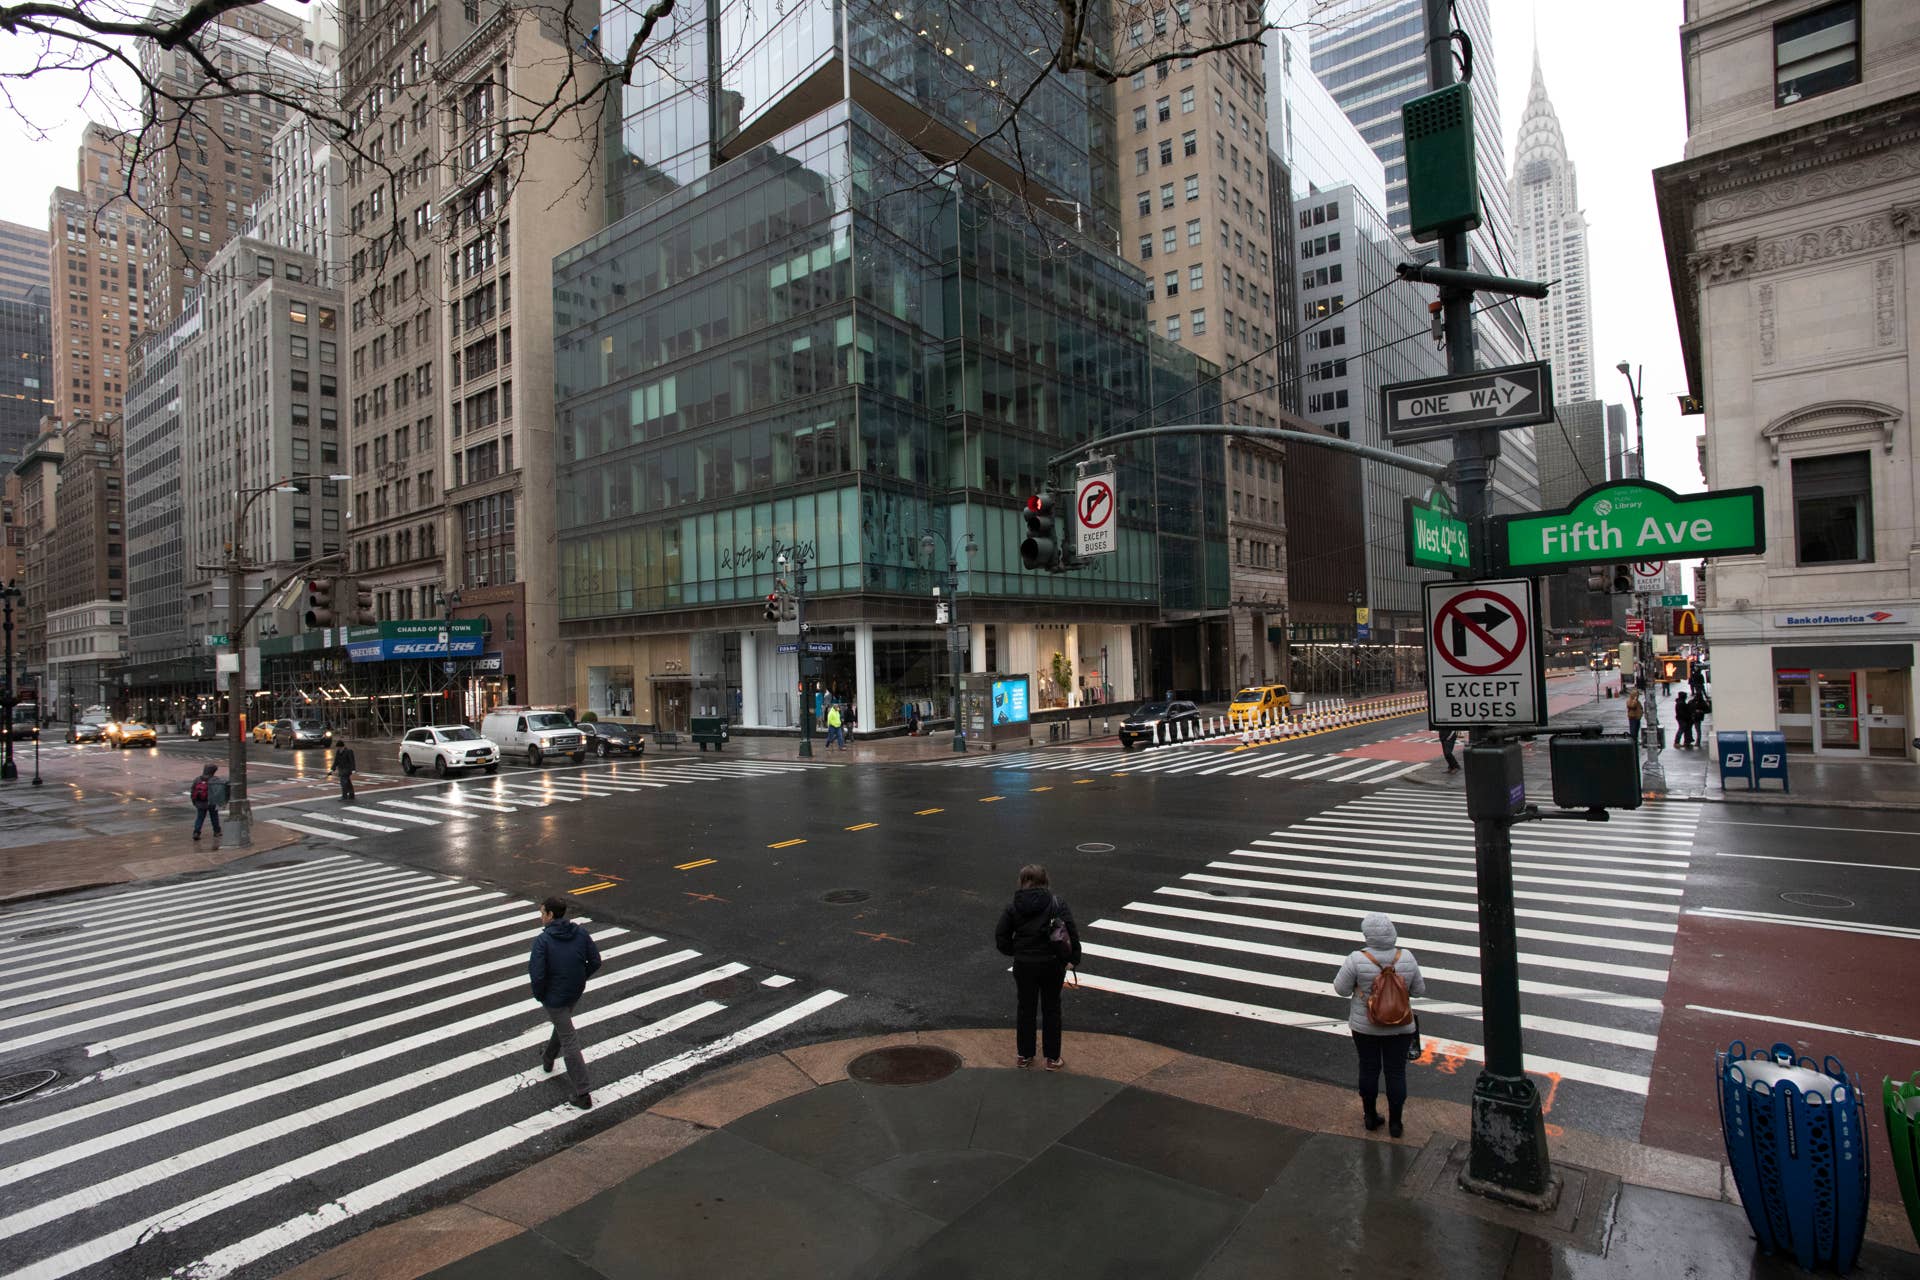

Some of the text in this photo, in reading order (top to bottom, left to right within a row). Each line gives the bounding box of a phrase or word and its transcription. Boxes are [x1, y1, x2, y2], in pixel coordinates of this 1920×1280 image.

[1411, 386, 1516, 416] ONE WAY
[1615, 501, 1643, 510] Library
[1083, 530, 1108, 542] EXCEPT
[1415, 517, 1440, 553] West
[1458, 530, 1468, 558] St
[1541, 517, 1713, 555] Fifth Ave
[1085, 541, 1107, 552] BUSES
[721, 548, 732, 570] &
[1667, 596, 1673, 605] 5
[1787, 615, 1865, 625] Bank of America
[350, 646, 381, 658] SKECHERS
[392, 642, 476, 654] SKECHERS
[1445, 681, 1520, 698] EXCEPT
[1451, 701, 1517, 718] BUSES
